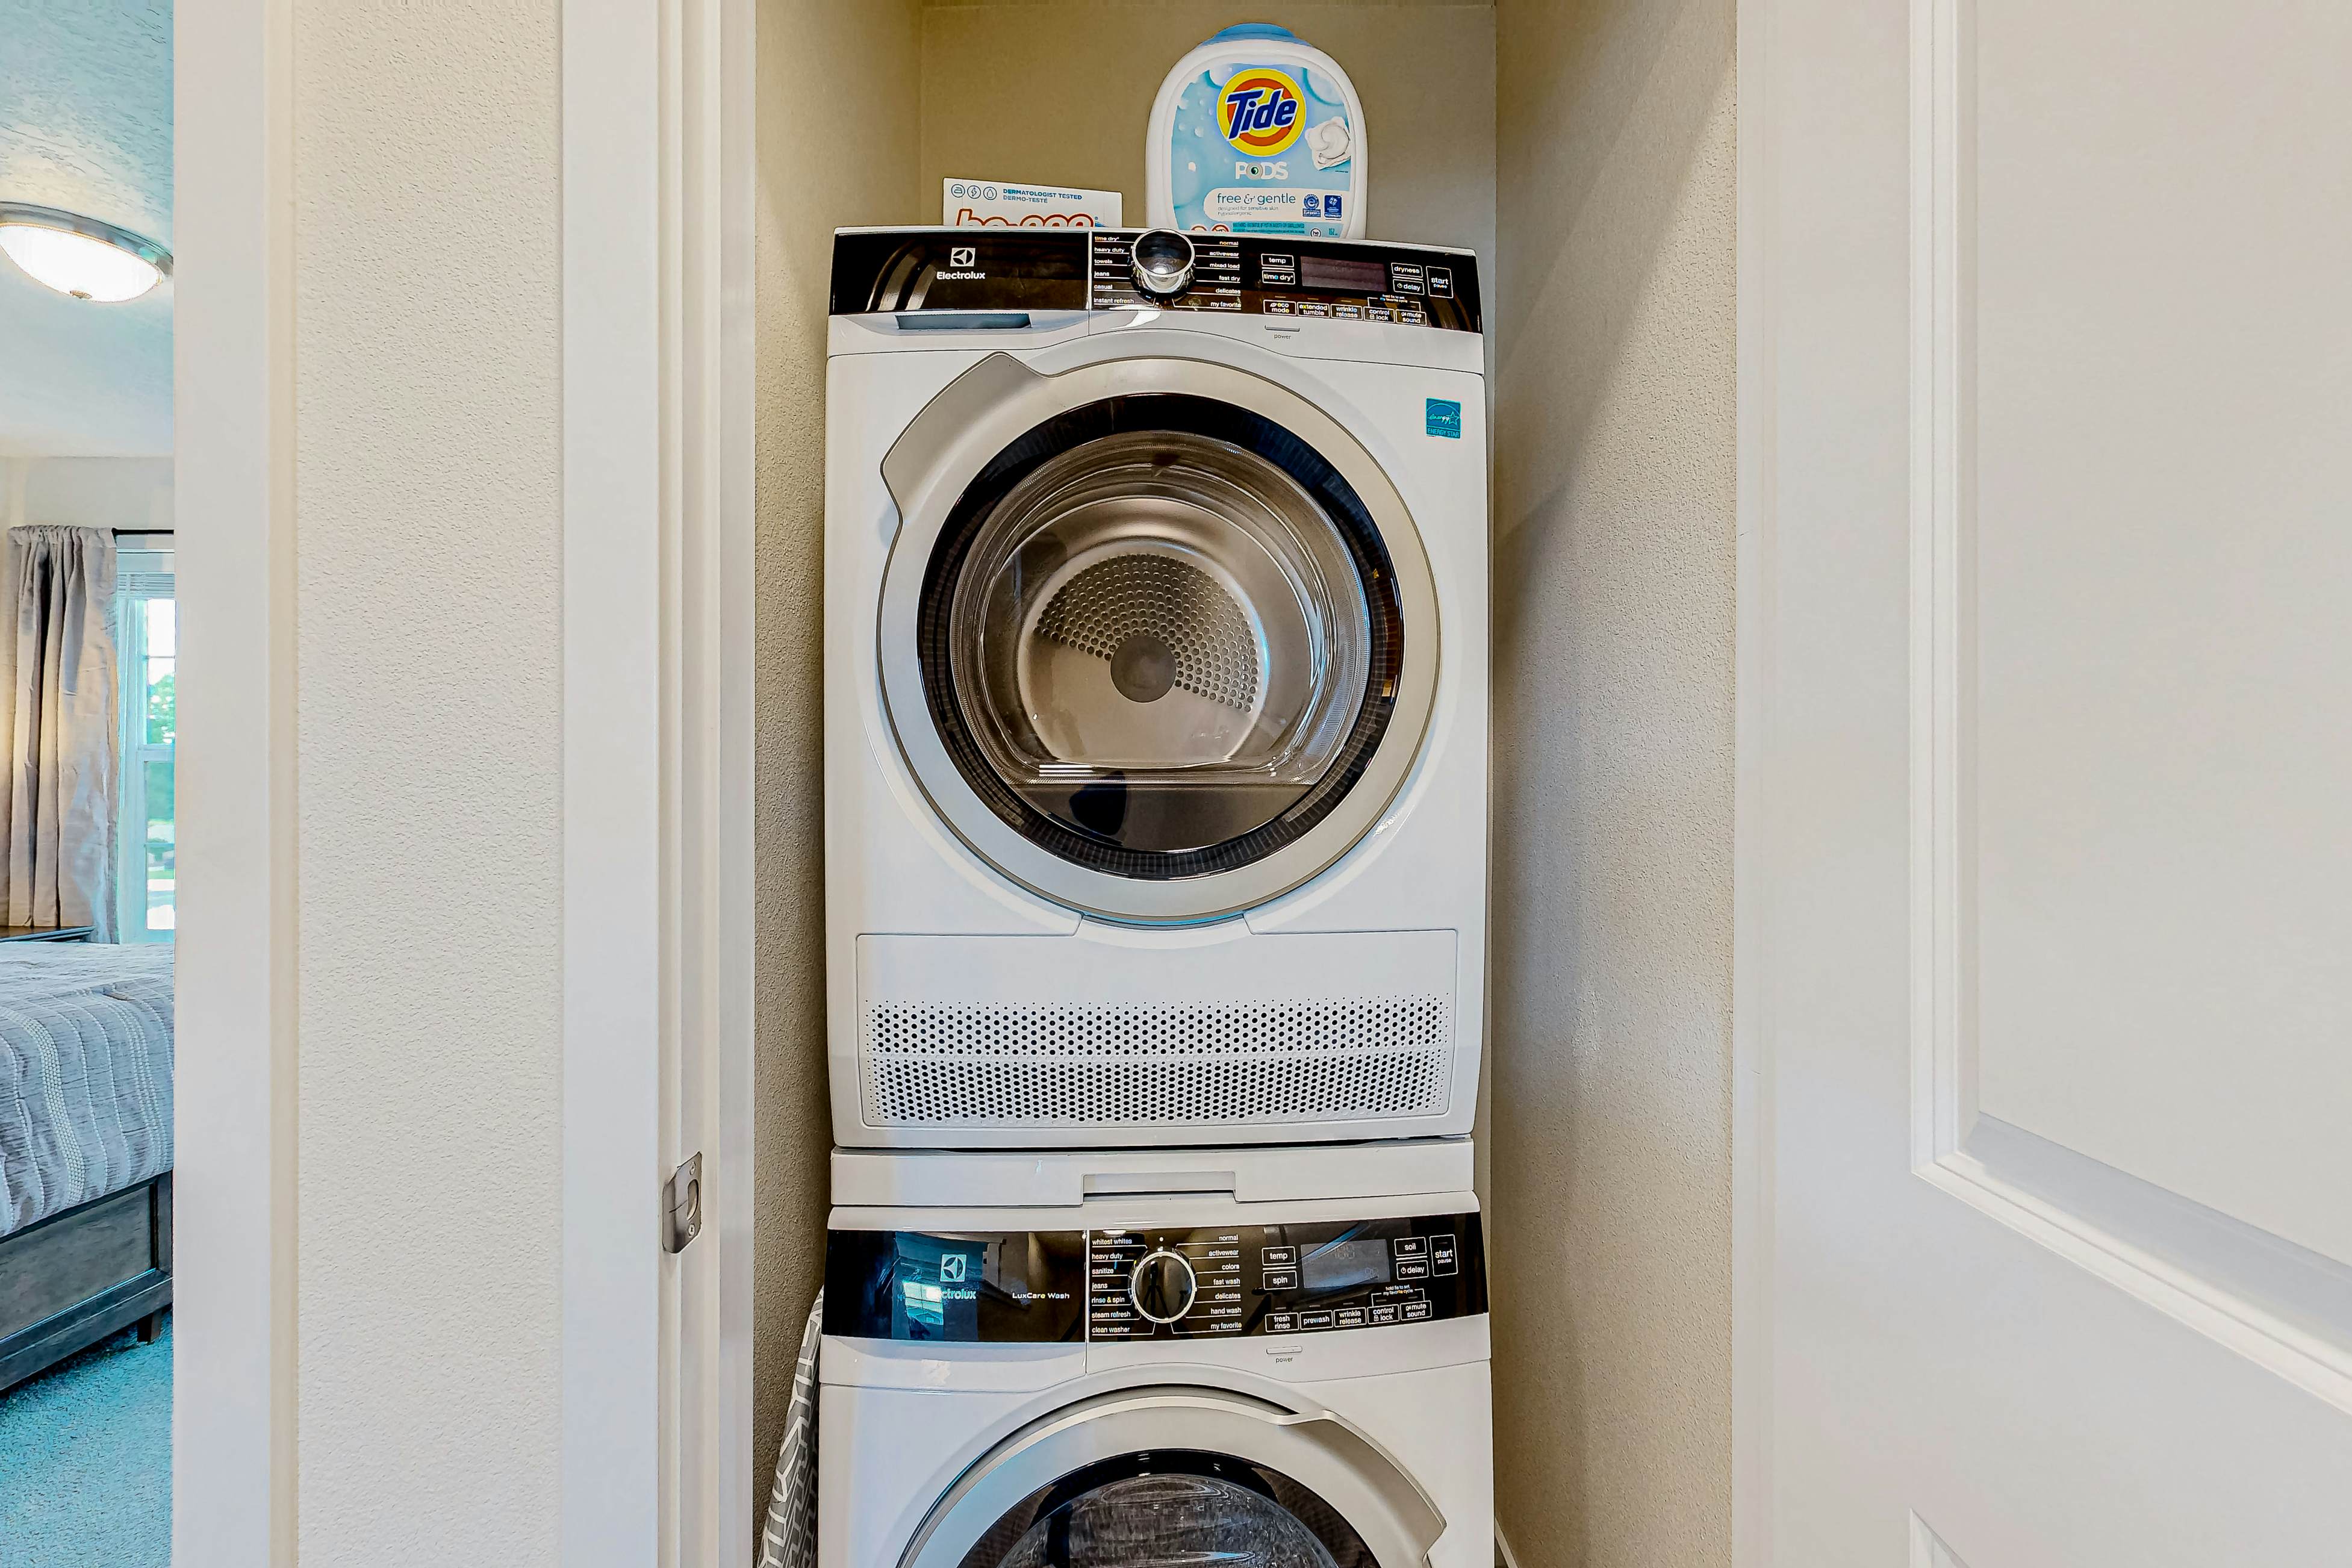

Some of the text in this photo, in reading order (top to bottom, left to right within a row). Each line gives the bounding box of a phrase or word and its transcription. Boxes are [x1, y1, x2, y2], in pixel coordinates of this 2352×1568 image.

[1227, 89, 1298, 140] Tide
[1235, 161, 1288, 180] PODS
[1003, 188, 1057, 198] DERMATOLOGIST
[1218, 193, 1296, 205] free & gentle
[936, 271, 986, 279] Electrolux
[1269, 1252, 1288, 1260] temp
[1435, 1249, 1453, 1258] start
[1407, 1266, 1425, 1274] delay
[1272, 1276, 1288, 1285] spin
[937, 1288, 977, 1299] ctrolux
[1303, 1315, 1330, 1324] prewash
